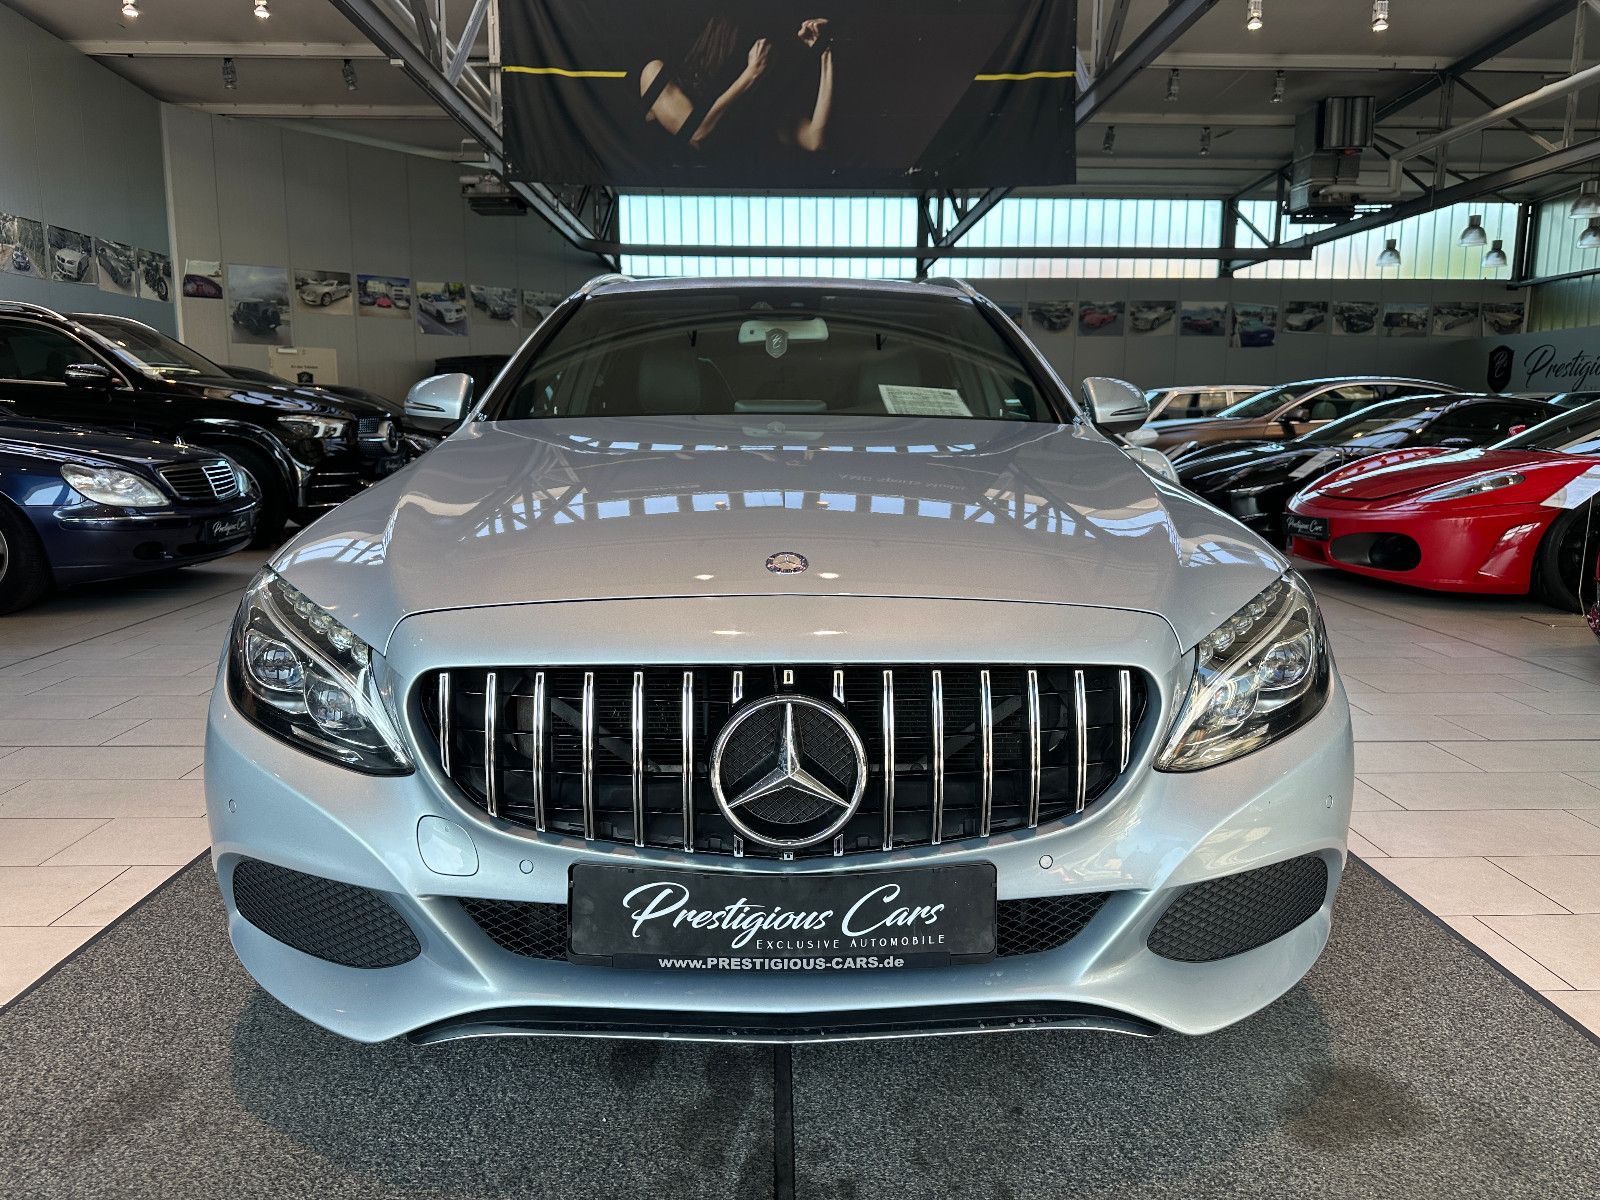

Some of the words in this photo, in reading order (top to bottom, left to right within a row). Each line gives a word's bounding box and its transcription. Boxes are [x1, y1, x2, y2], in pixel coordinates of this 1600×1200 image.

[622, 881, 834, 949] Prestigious
[841, 883, 945, 937] Cars
[756, 939, 840, 950] EXCLUSIVE
[850, 934, 945, 948] AUTOMOBILE
[658, 955, 905, 970] www.PRESTIGIOUS-CARS.de
